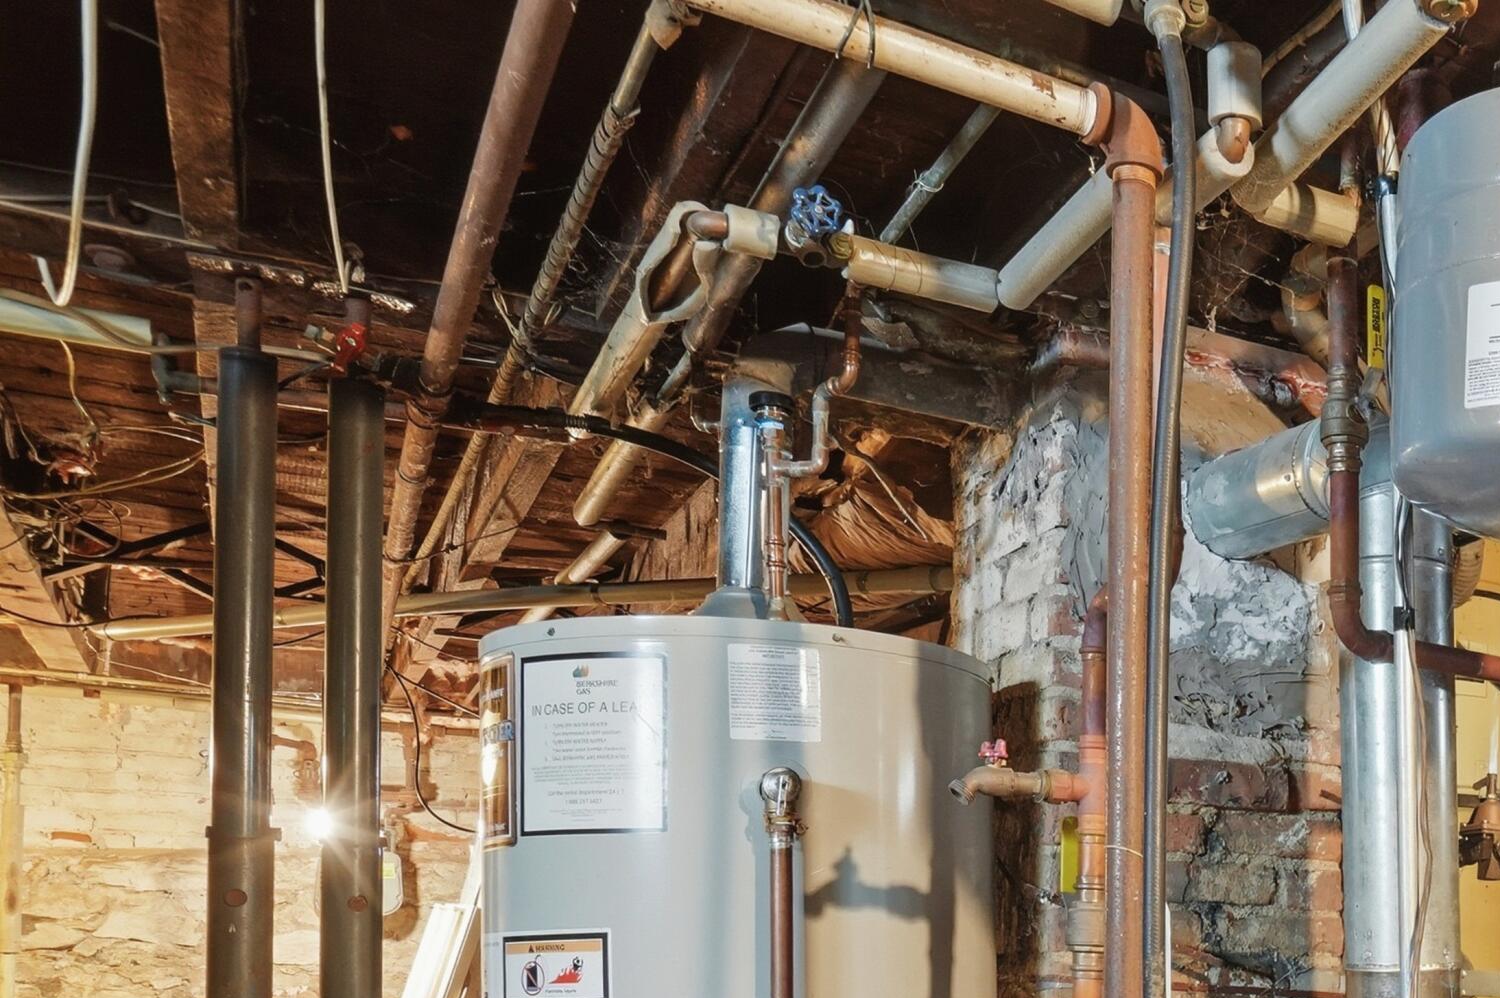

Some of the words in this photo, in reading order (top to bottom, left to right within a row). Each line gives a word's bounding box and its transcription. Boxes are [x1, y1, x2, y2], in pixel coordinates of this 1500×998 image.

[531, 704, 542, 717] IN
[543, 702, 575, 716] CASE
[577, 701, 596, 714] OF
[599, 702, 608, 713] A
[611, 701, 638, 713] LEA
